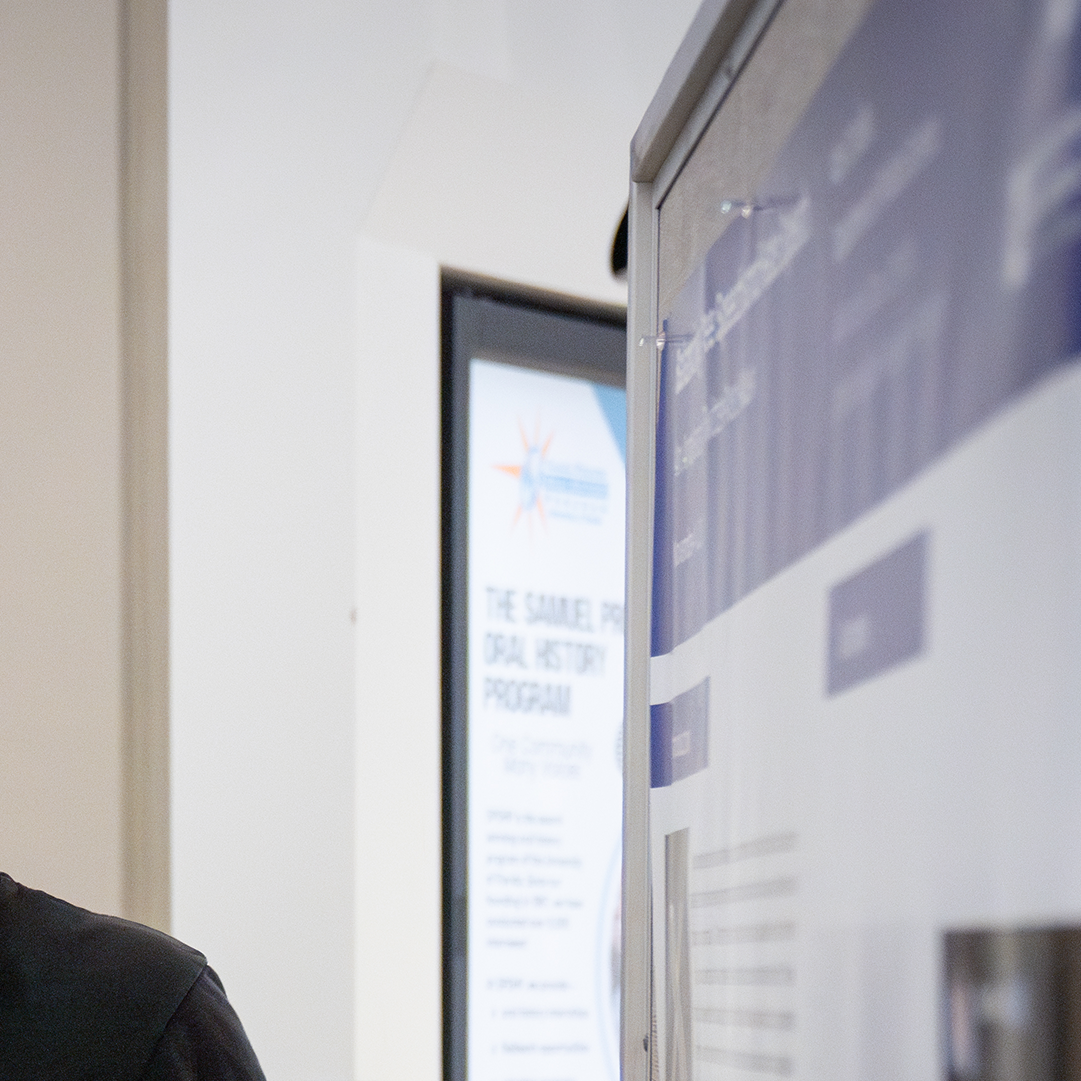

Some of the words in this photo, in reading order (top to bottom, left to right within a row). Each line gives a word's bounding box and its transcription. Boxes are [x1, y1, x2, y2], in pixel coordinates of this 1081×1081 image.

[486, 586, 517, 623] THE
[525, 591, 594, 634] SAMUEL
[601, 600, 624, 636] PR
[535, 638, 606, 676] HISTORY
[483, 676, 572, 716] PROGRAM
